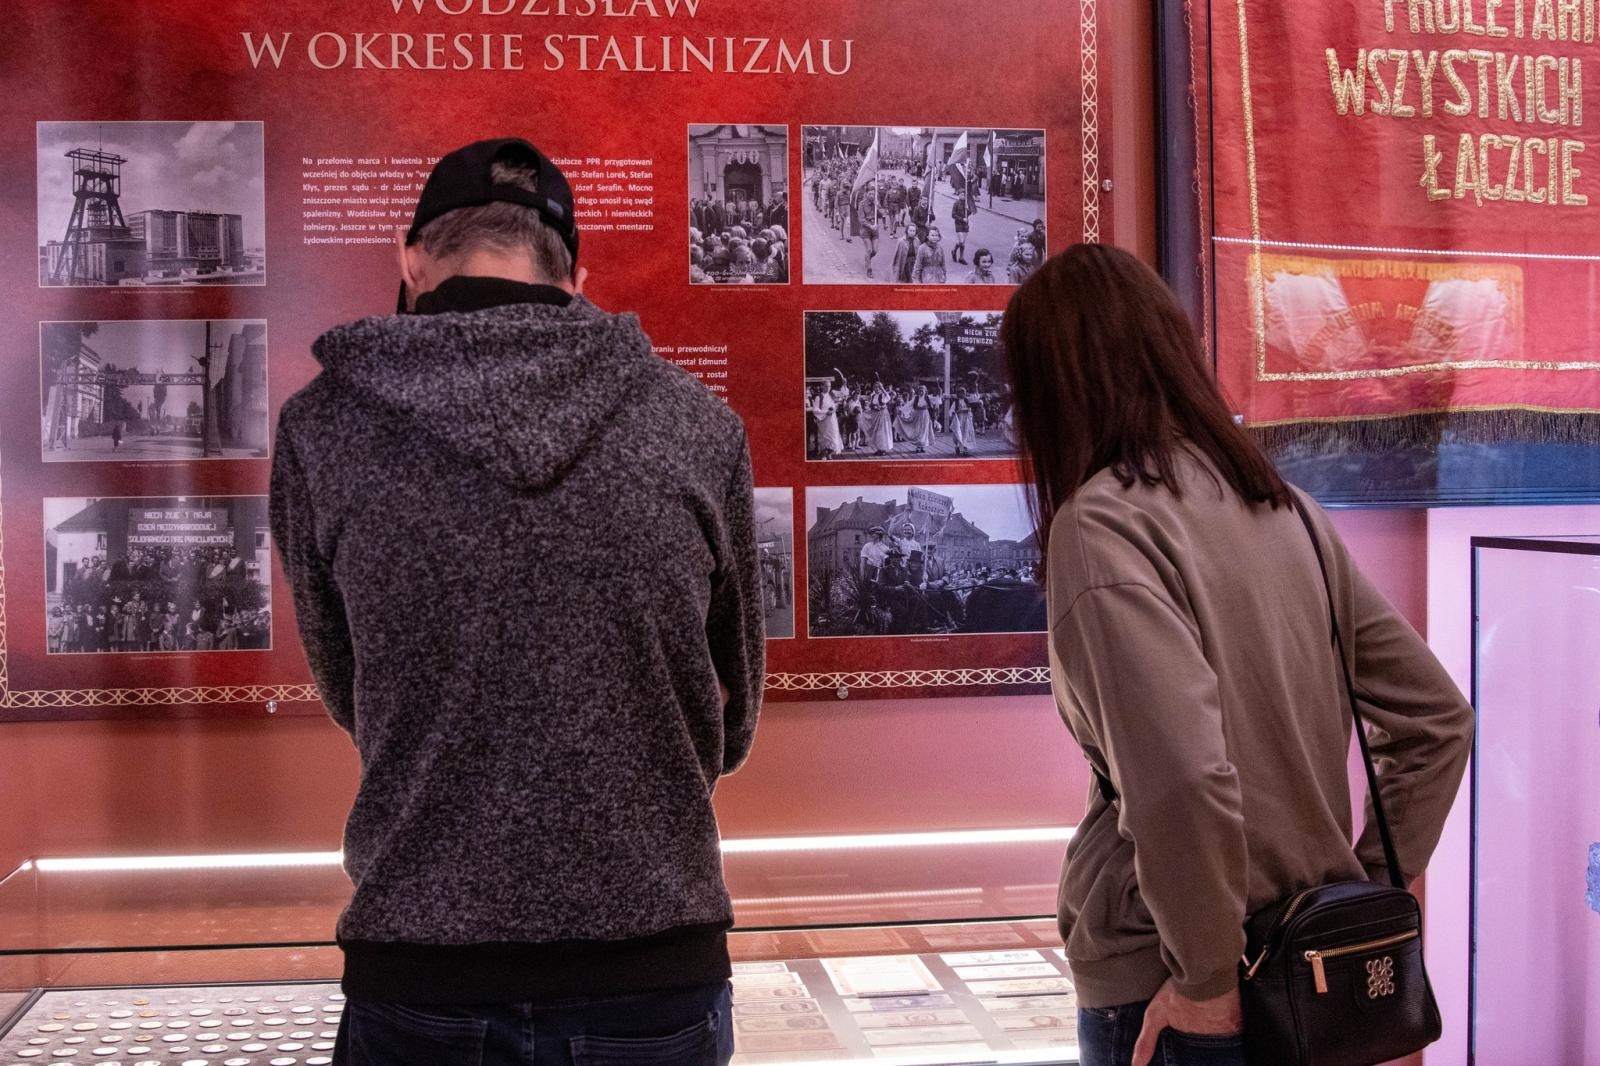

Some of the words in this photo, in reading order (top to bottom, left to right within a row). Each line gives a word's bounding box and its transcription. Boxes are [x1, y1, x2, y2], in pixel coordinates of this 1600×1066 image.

[1383, 0, 1600, 43] PROLETARI
[240, 32, 293, 69] W
[308, 32, 524, 70] OKRESIE
[543, 34, 854, 75] STALINIZMU
[1325, 48, 1582, 126] WSZYSTKICH
[302, 157, 313, 165] Na
[317, 157, 353, 167] przełomie
[391, 157, 422, 165] kwietnia
[427, 157, 443, 165] 194
[604, 158, 653, 168] przygotowani
[302, 170, 338, 179] wcześniej
[339, 170, 349, 178] do
[351, 170, 377, 179] objęcia
[379, 170, 404, 179] władzy
[1419, 133, 1588, 207] ŁĄCZCIE
[606, 171, 628, 180] Lorek,
[302, 184, 320, 192] Kłys,
[324, 185, 348, 193] prezes
[351, 184, 369, 192] sądu
[380, 183, 389, 191] dr
[393, 183, 411, 191] Józef
[575, 184, 593, 192] Józef
[597, 184, 624, 192] Serafin.
[628, 184, 653, 192] Mocno
[369, 197, 389, 206] wciąż
[577, 197, 598, 206] długo
[622, 197, 633, 206] się
[634, 197, 653, 206] swąd
[303, 210, 343, 218] spalenizny.
[389, 210, 401, 218] był
[303, 223, 338, 232] żołnierzy.
[575, 223, 614, 232] iszczonym
[303, 236, 343, 245] żydowskim
[345, 236, 391, 244] przeniesiono
[677, 344, 727, 354] przewodniczył
[698, 357, 728, 365] Edmund
[706, 370, 728, 378] został
